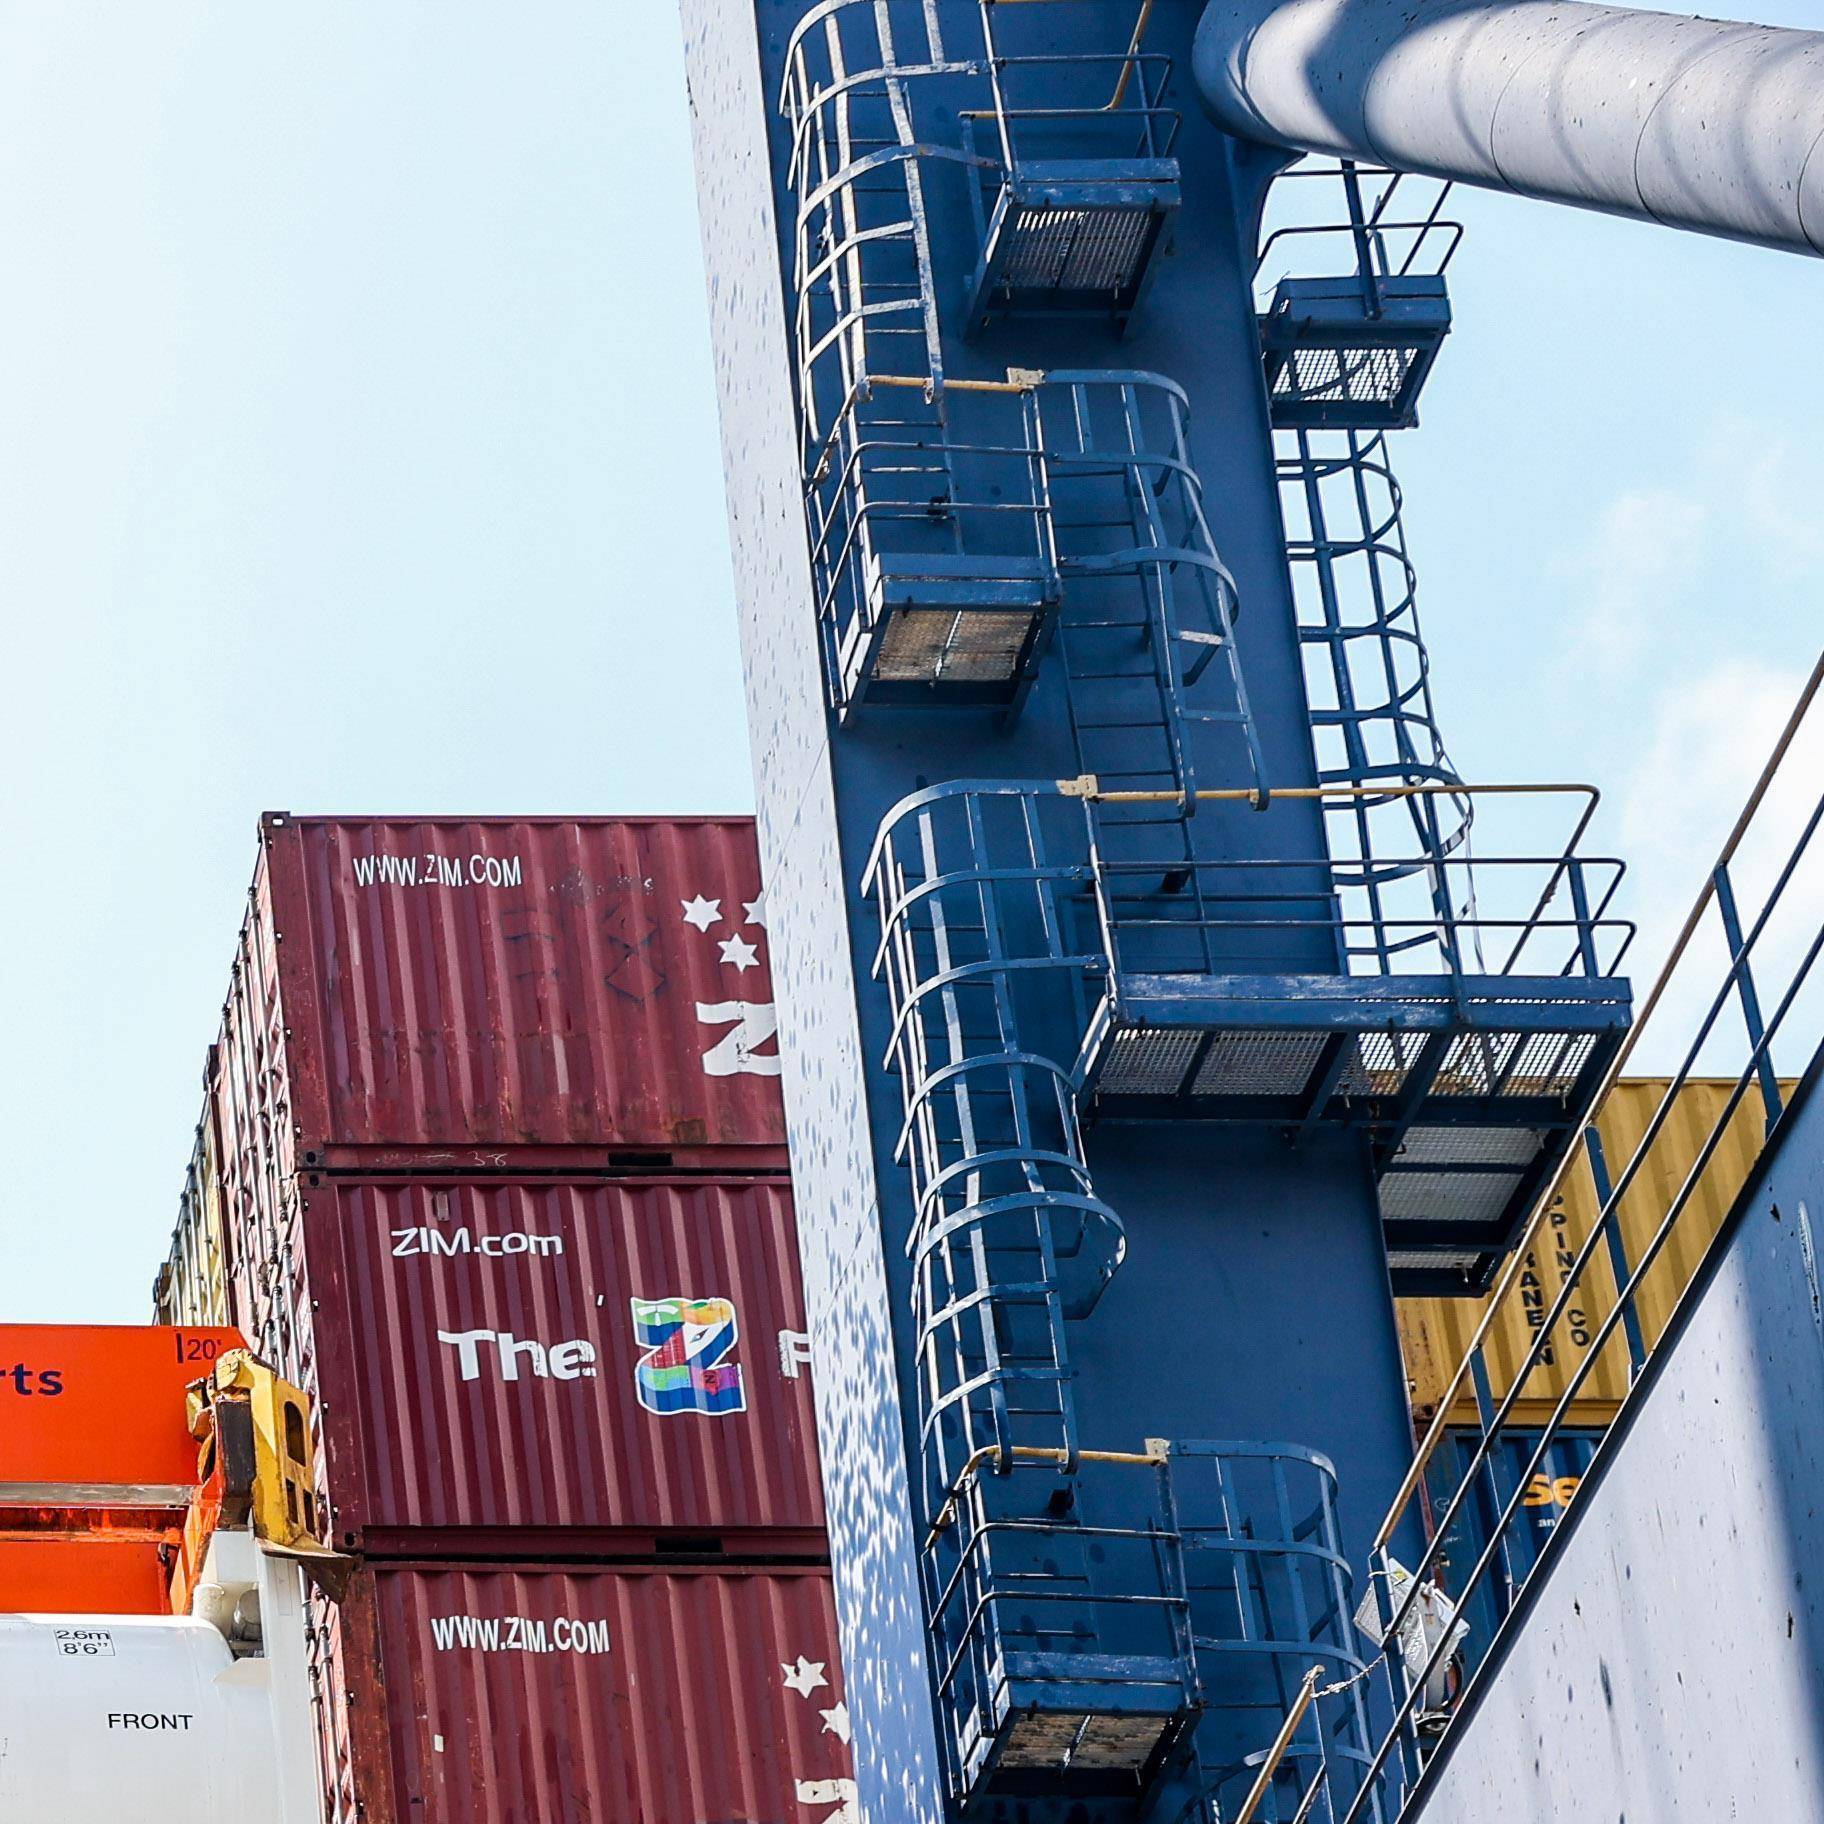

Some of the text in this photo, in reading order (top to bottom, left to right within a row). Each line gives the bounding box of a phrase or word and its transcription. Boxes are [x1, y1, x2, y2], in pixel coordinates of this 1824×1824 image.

[353, 855, 521, 887] WWW.ZIM.COM
[391, 1227, 562, 1257] ZIM.com
[437, 1328, 596, 1380] The
[431, 1615, 610, 1654] WWW.ZIM.COM
[108, 1713, 193, 1730] FRONT
